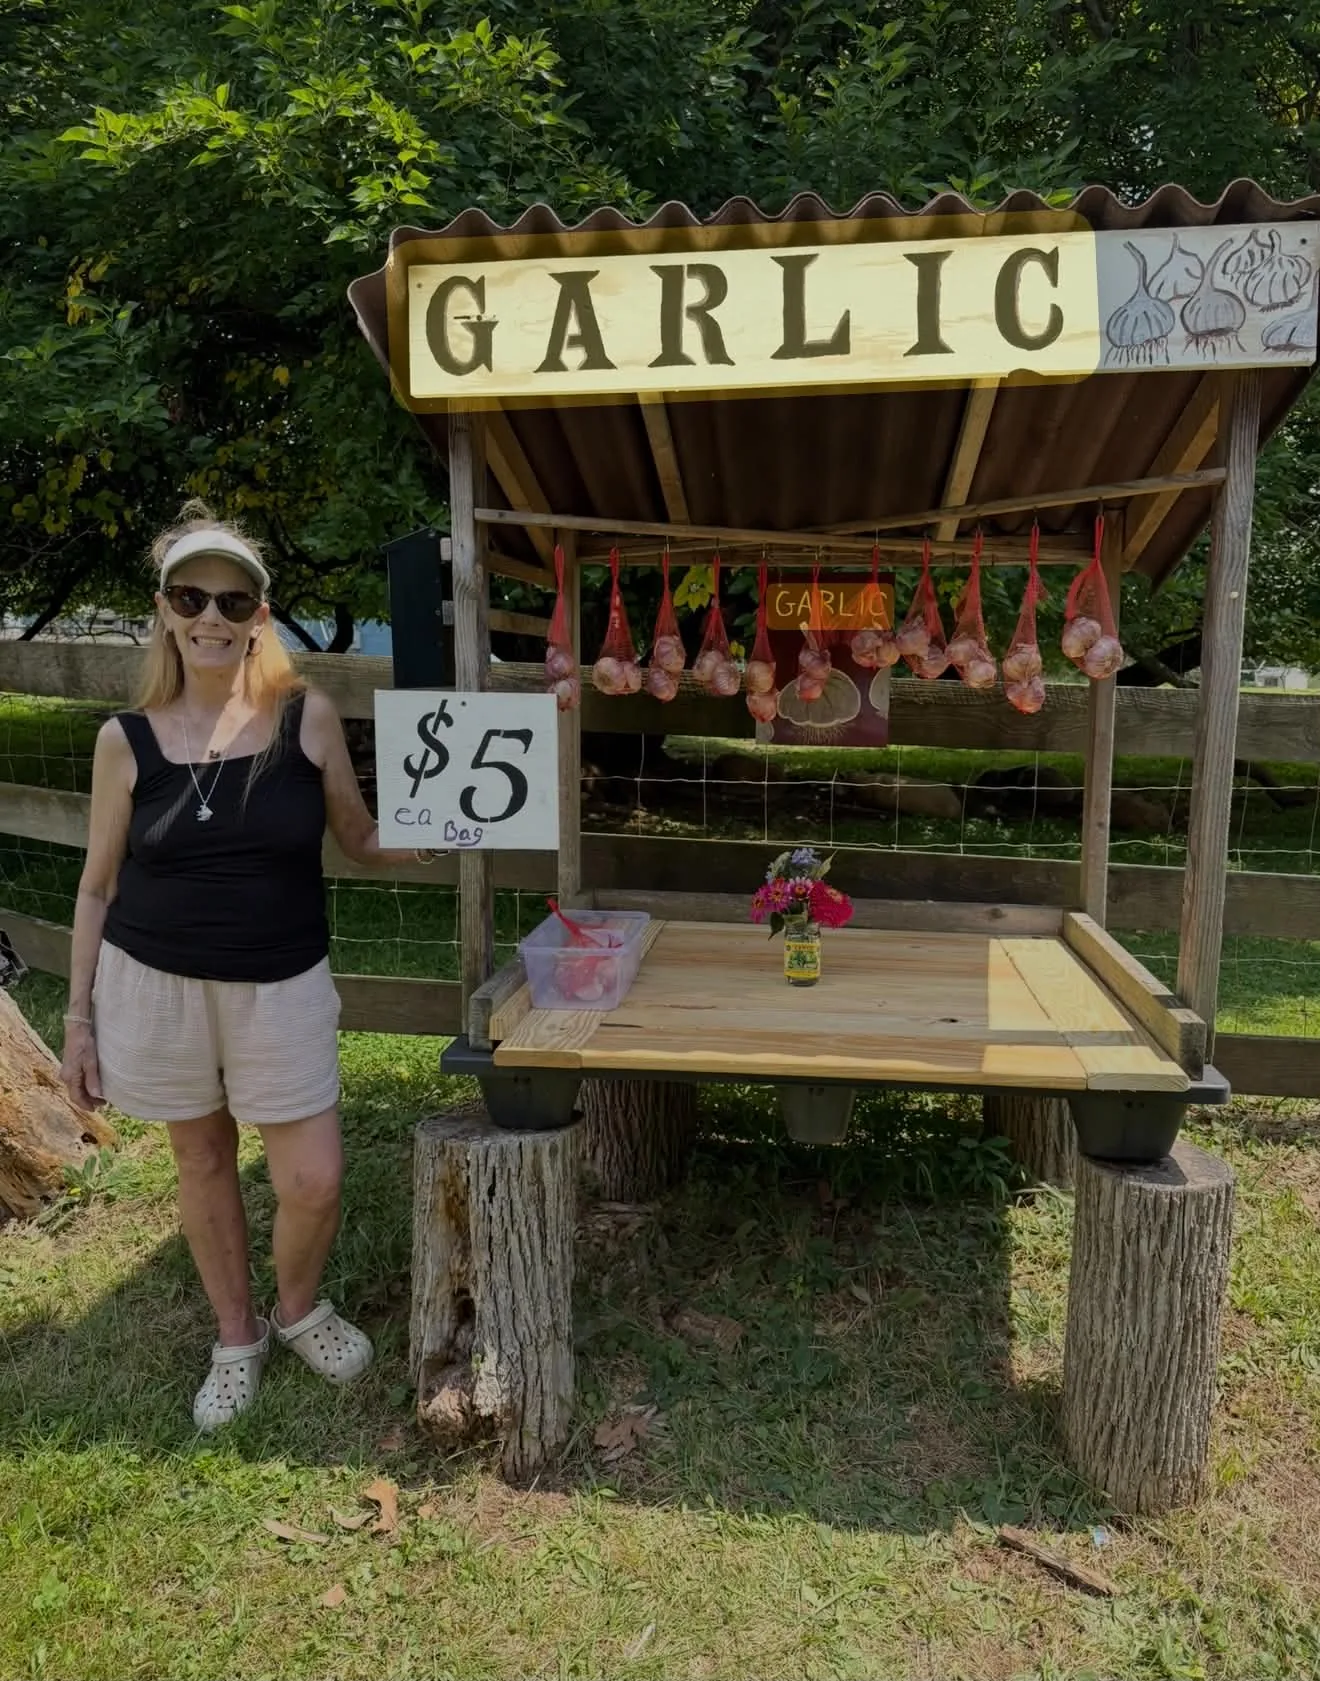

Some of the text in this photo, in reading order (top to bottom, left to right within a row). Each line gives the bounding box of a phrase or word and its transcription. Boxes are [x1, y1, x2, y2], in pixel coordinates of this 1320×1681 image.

[425, 246, 1064, 376] GARLIC
[775, 589, 888, 617] GARLIC
[403, 699, 533, 823] $5
[443, 820, 483, 847] Bag
